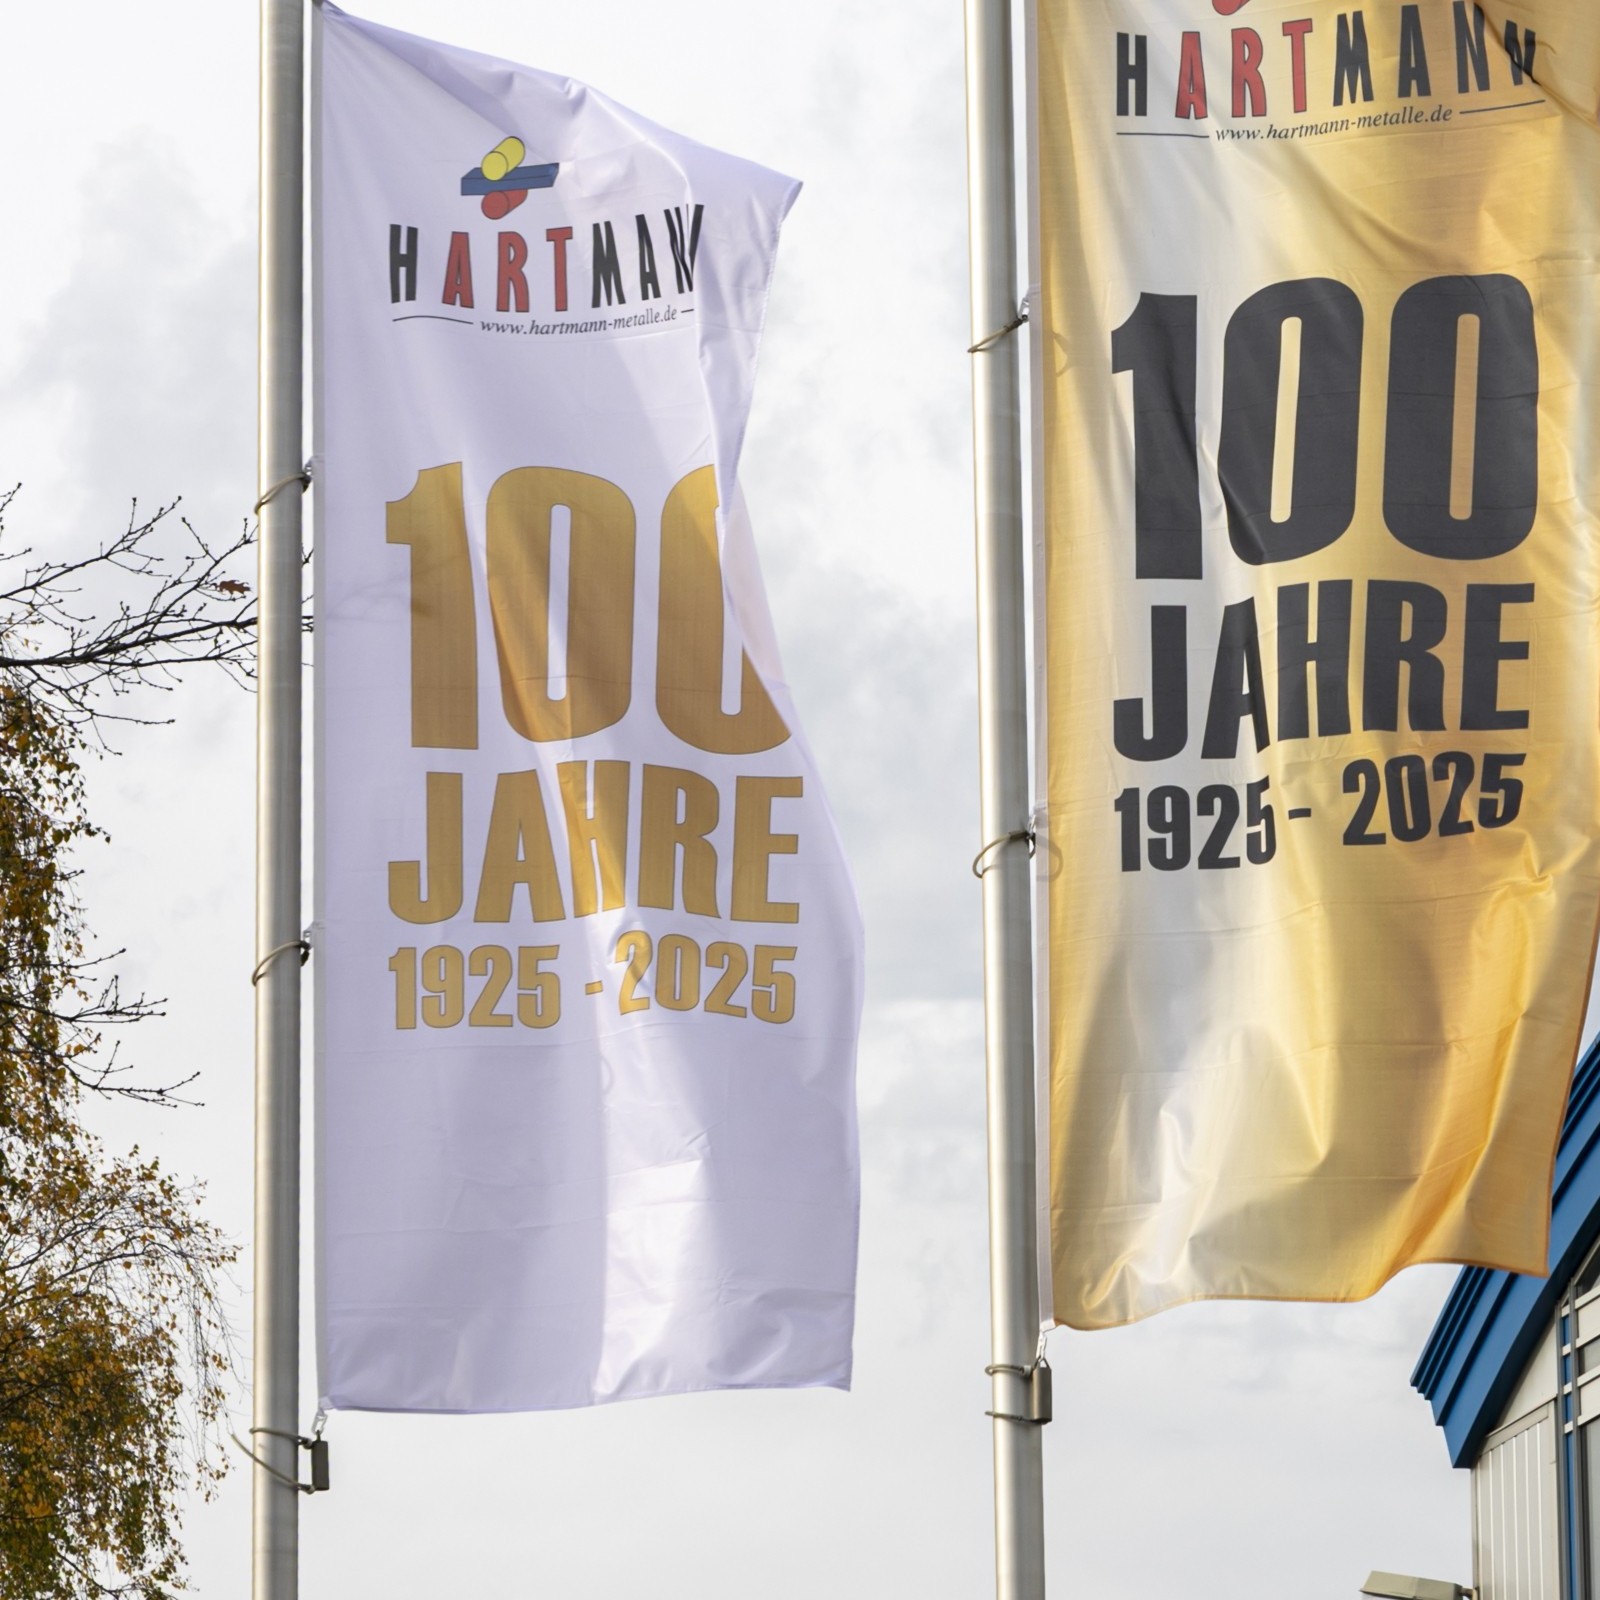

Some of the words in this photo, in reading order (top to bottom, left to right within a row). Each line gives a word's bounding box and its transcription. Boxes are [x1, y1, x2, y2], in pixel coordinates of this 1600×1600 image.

[1115, 0, 1536, 120] HARTMANN
[1216, 104, 1453, 141] www.hartmann-metalle.de
[480, 305, 677, 335] www.hartmann-metalle.de
[1111, 273, 1539, 580] 100
[386, 461, 792, 755] 100
[1113, 579, 1535, 762] JAHRE
[388, 760, 803, 925] JAHRE
[1114, 775, 1277, 872] 1925
[1342, 751, 1527, 846] 2025
[389, 945, 560, 1029] 1925
[614, 930, 797, 1024] 2025
